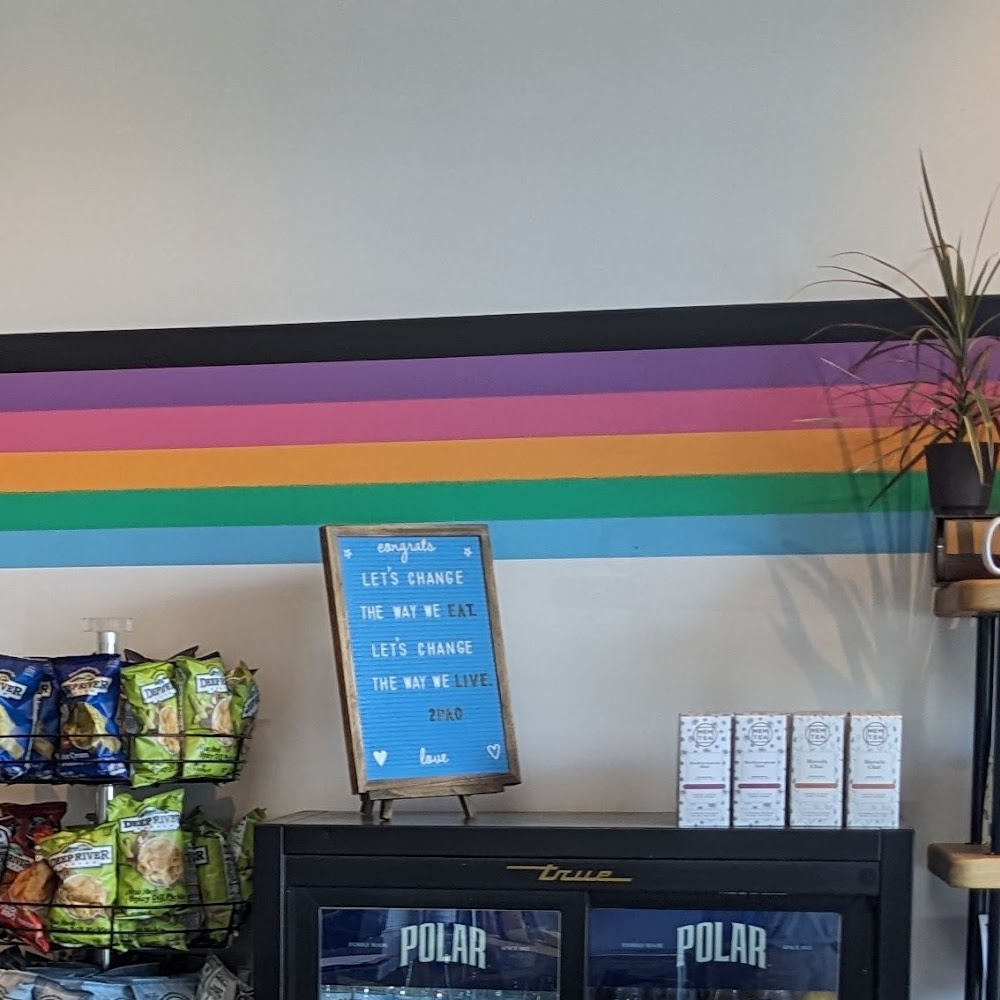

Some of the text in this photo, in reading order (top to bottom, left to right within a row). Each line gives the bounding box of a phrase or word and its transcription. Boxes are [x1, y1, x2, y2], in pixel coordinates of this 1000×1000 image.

[377, 539, 436, 563] congrats
[362, 566, 463, 587] LET'S CHANGE
[360, 605, 383, 620] THE
[392, 604, 417, 619] WAY
[423, 604, 441, 618] WE
[371, 637, 473, 657] LET'S CHANGE
[372, 677, 397, 691] THE
[403, 675, 426, 690] WAY
[432, 674, 449, 689] WE
[419, 748, 449, 765] love
[124, 818, 151, 830] DEEP
[76, 849, 111, 863] RIVER
[507, 864, 632, 882] true
[400, 922, 487, 970] POLAR
[676, 921, 767, 969] POLAR
